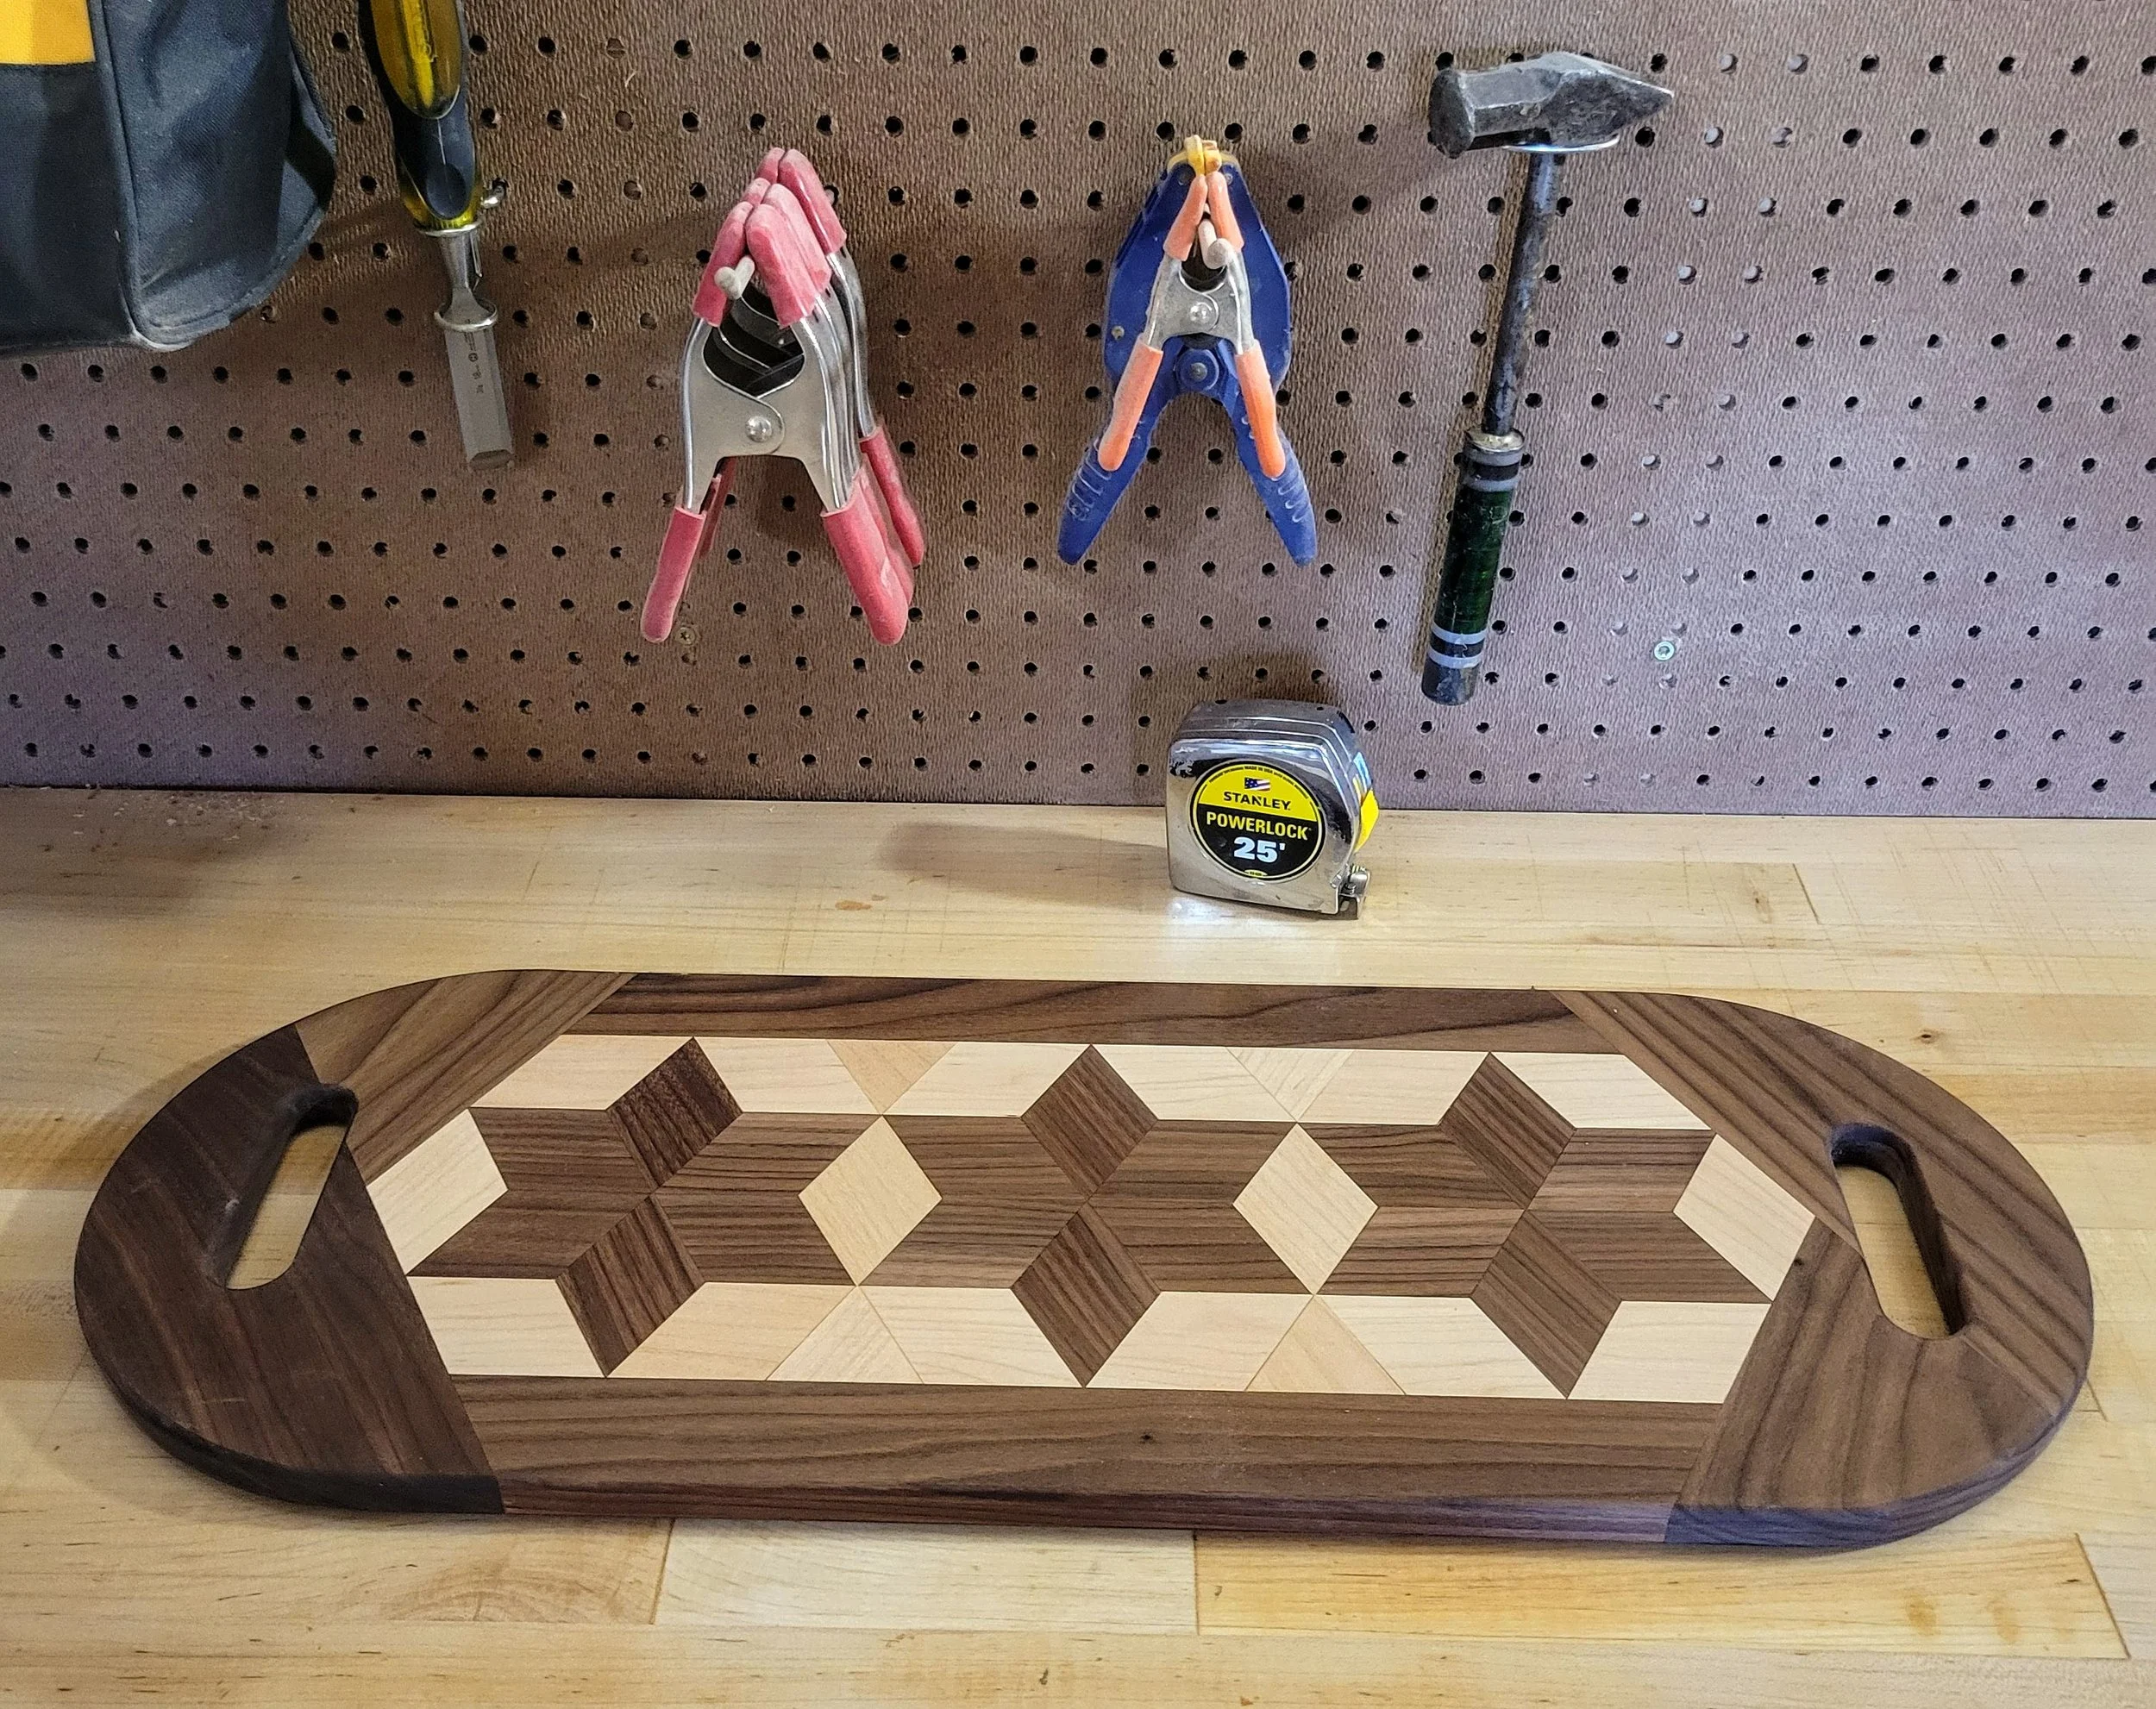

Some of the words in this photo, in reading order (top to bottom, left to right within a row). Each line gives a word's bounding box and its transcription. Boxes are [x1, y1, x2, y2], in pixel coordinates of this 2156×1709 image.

[1224, 791, 1291, 811] STANLEY
[1206, 811, 1308, 841] POWERLOCK
[1233, 836, 1286, 863] 25'
